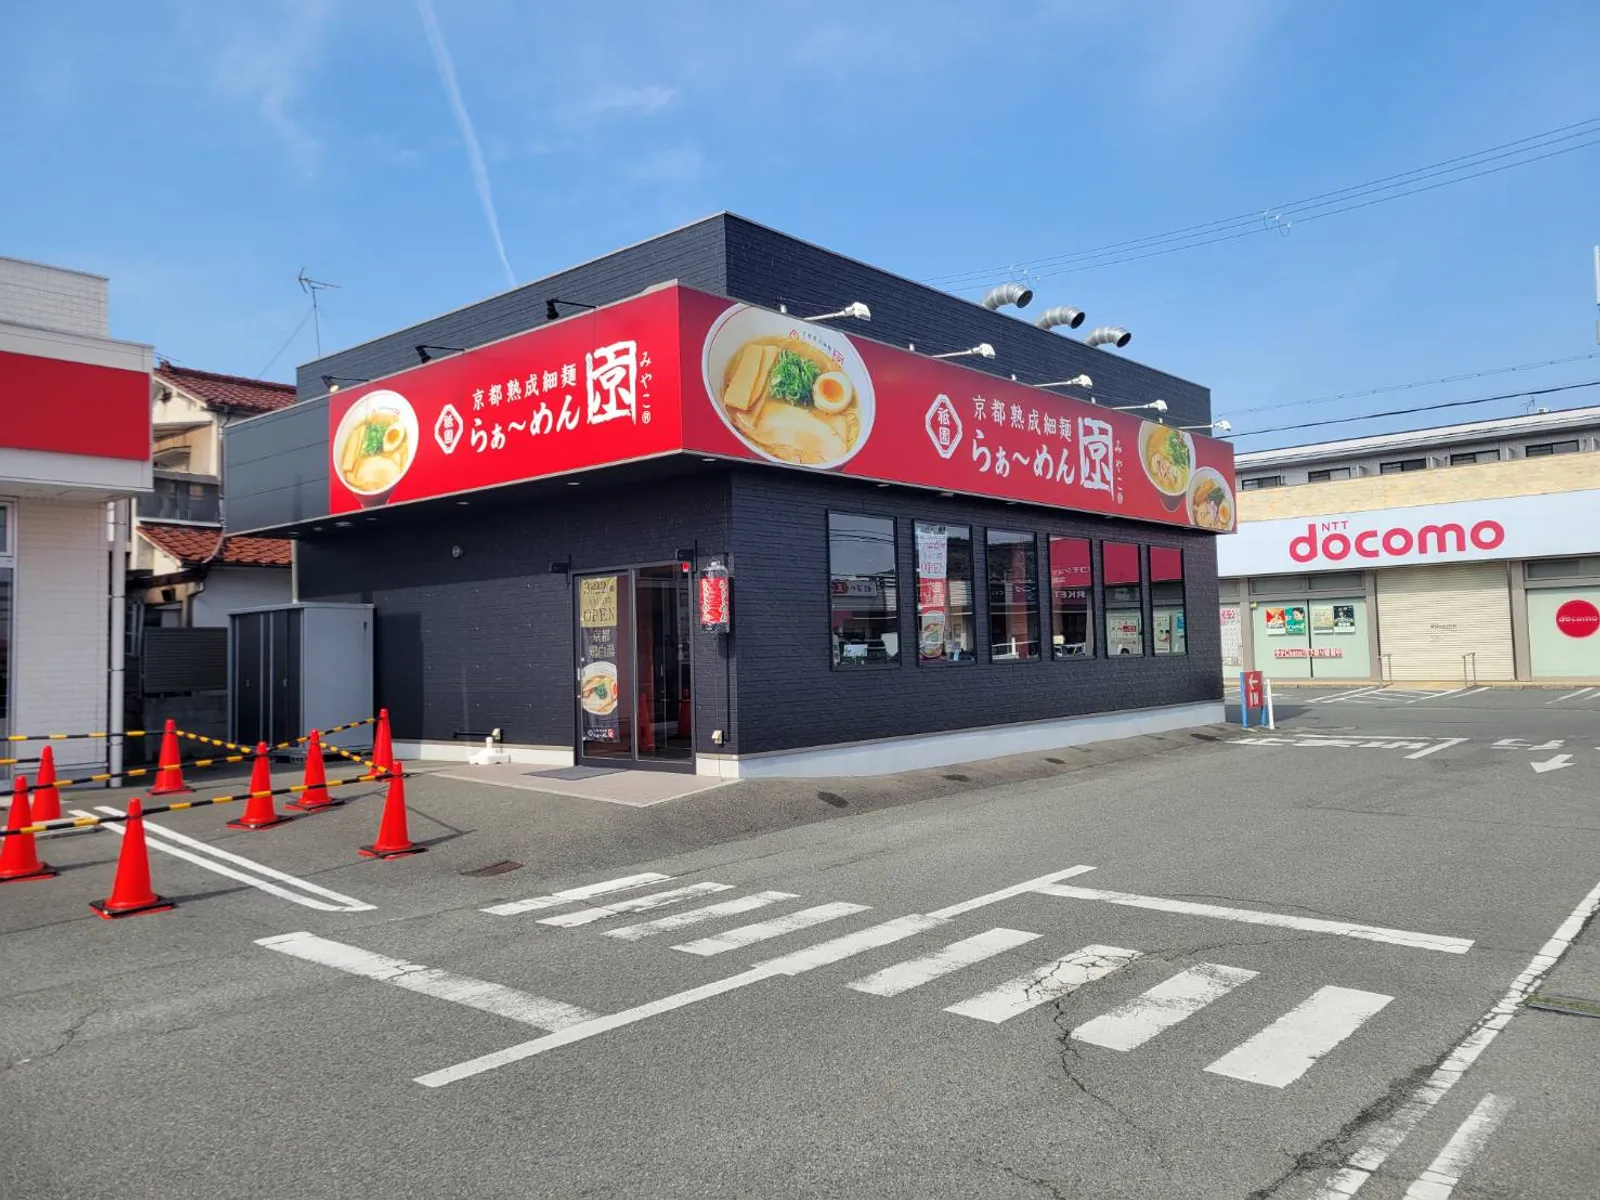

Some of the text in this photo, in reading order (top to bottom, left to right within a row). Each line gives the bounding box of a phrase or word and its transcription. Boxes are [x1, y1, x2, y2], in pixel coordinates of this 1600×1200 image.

[472, 363, 577, 411] 京都熟成細麺
[937, 407, 951, 446] 祇園
[972, 394, 1072, 442] 京都熟成細麺
[1289, 520, 1505, 563] docomo
[1321, 520, 1349, 532] NTT
[583, 606, 616, 623] OPEN
